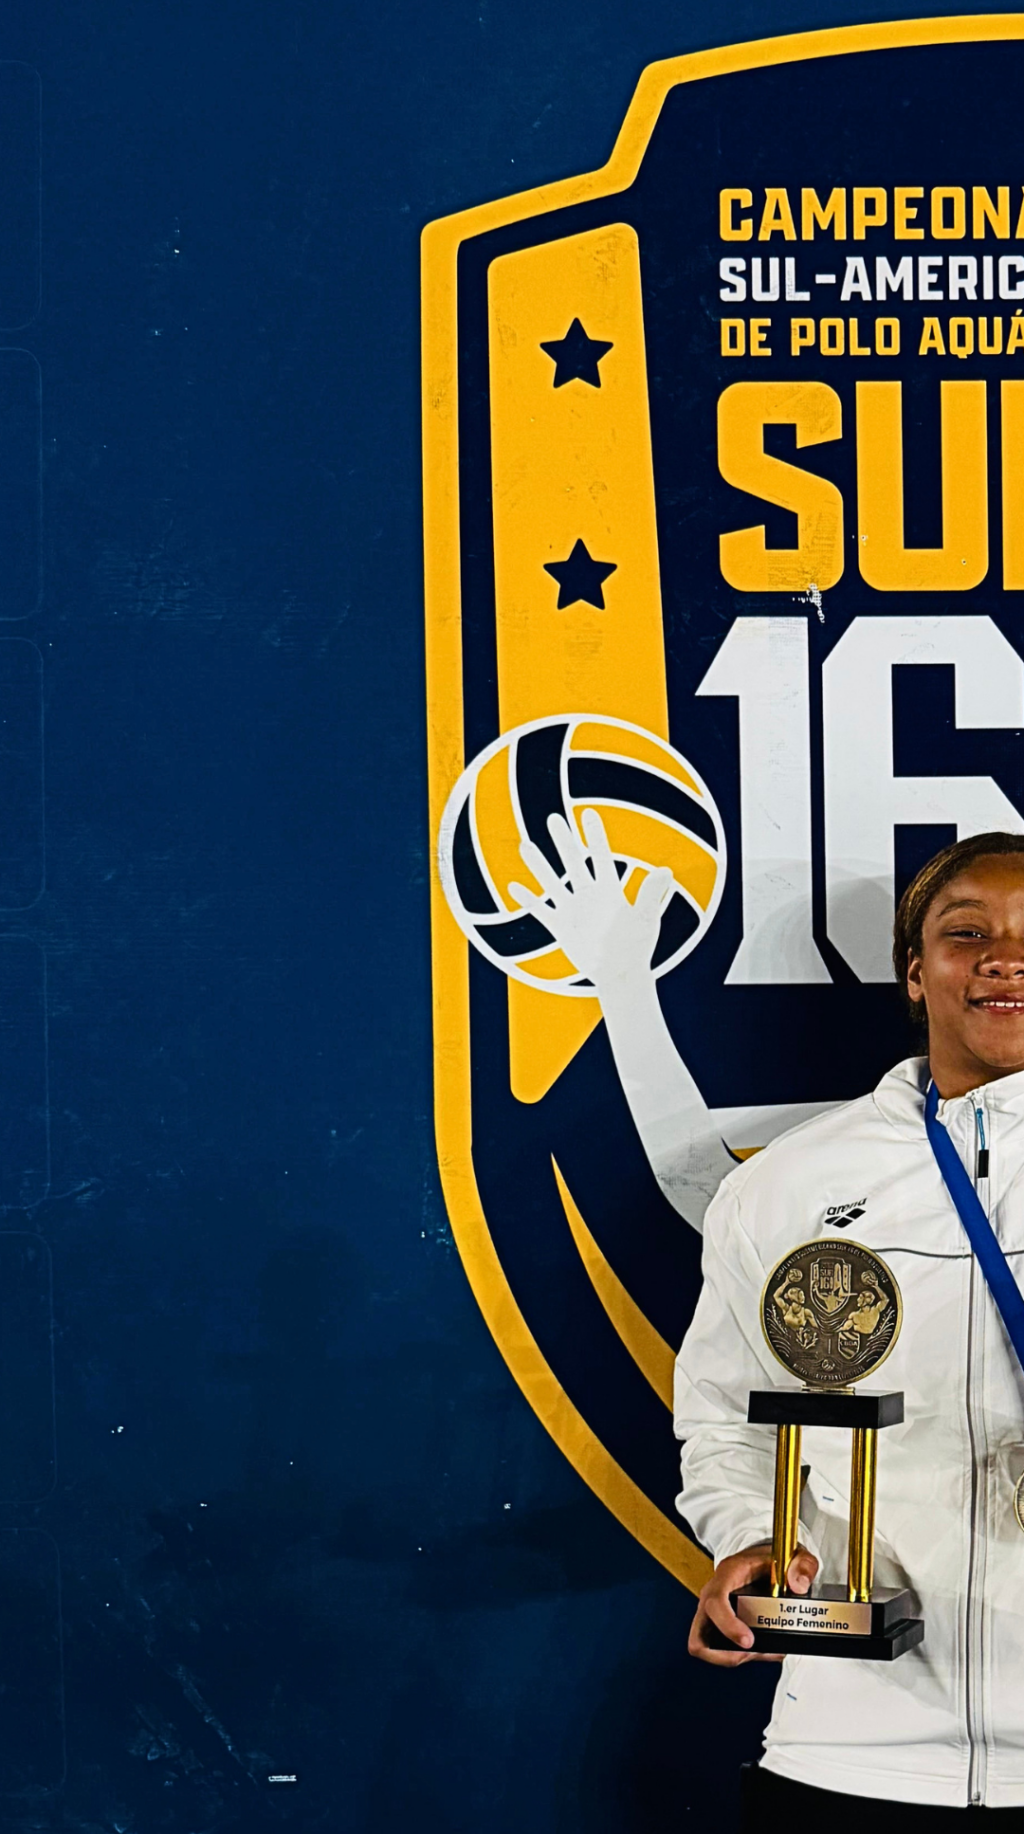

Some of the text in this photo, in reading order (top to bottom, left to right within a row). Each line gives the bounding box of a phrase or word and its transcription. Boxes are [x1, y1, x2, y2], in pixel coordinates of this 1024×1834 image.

[721, 318, 773, 357] DE
[790, 317, 901, 357] POLO
[780, 1603, 829, 1616] 1.er Lugar
[757, 1615, 849, 1630] Equipo Femenino
